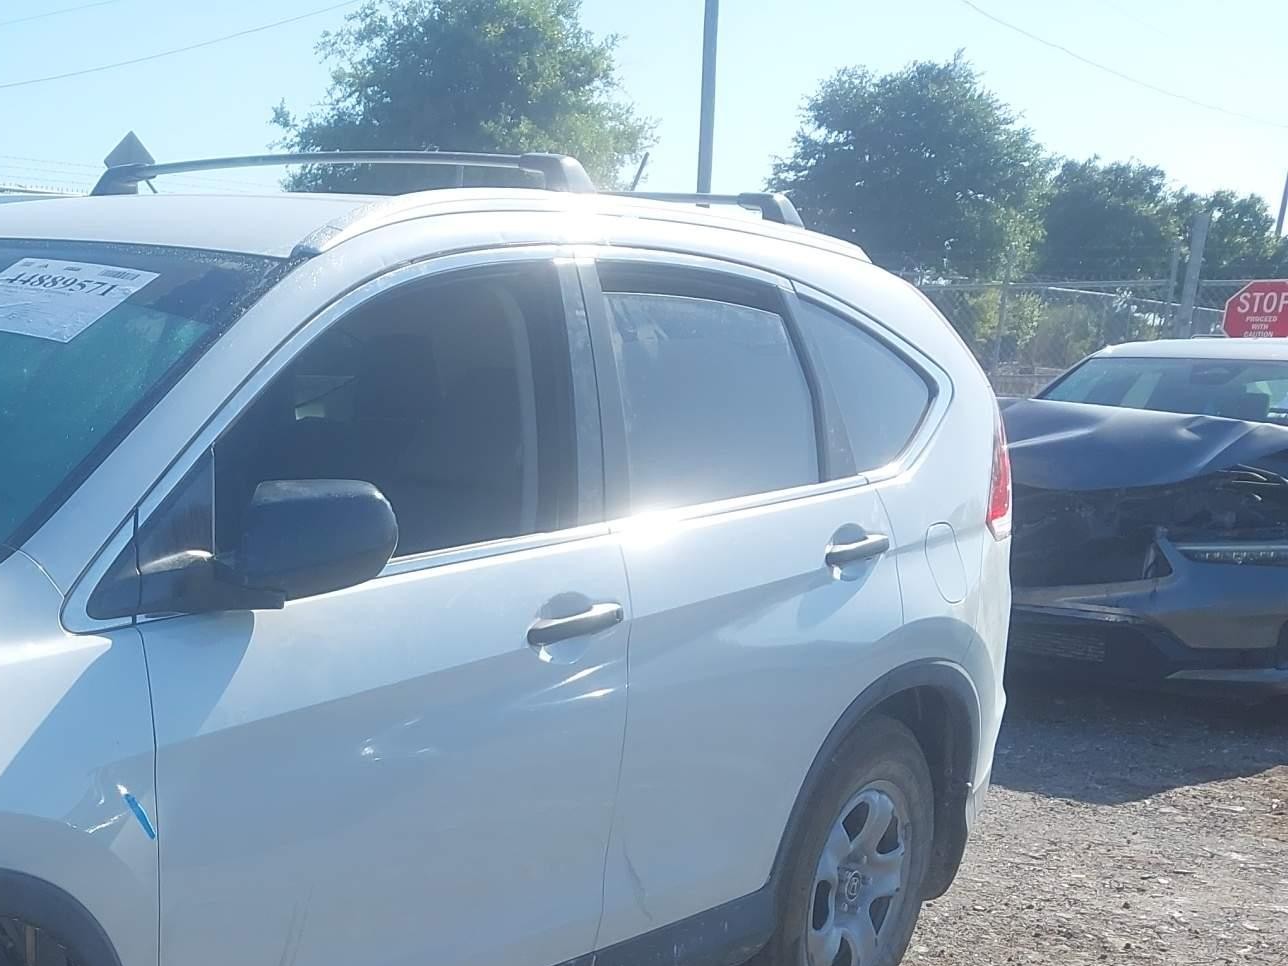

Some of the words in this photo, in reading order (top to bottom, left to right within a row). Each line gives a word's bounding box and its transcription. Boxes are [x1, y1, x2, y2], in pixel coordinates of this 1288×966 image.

[4, 272, 118, 296] 44889571
[1246, 315, 1278, 323] PROCEED
[1252, 323, 1269, 331] WITH
[1243, 330, 1274, 338] CAUTION
